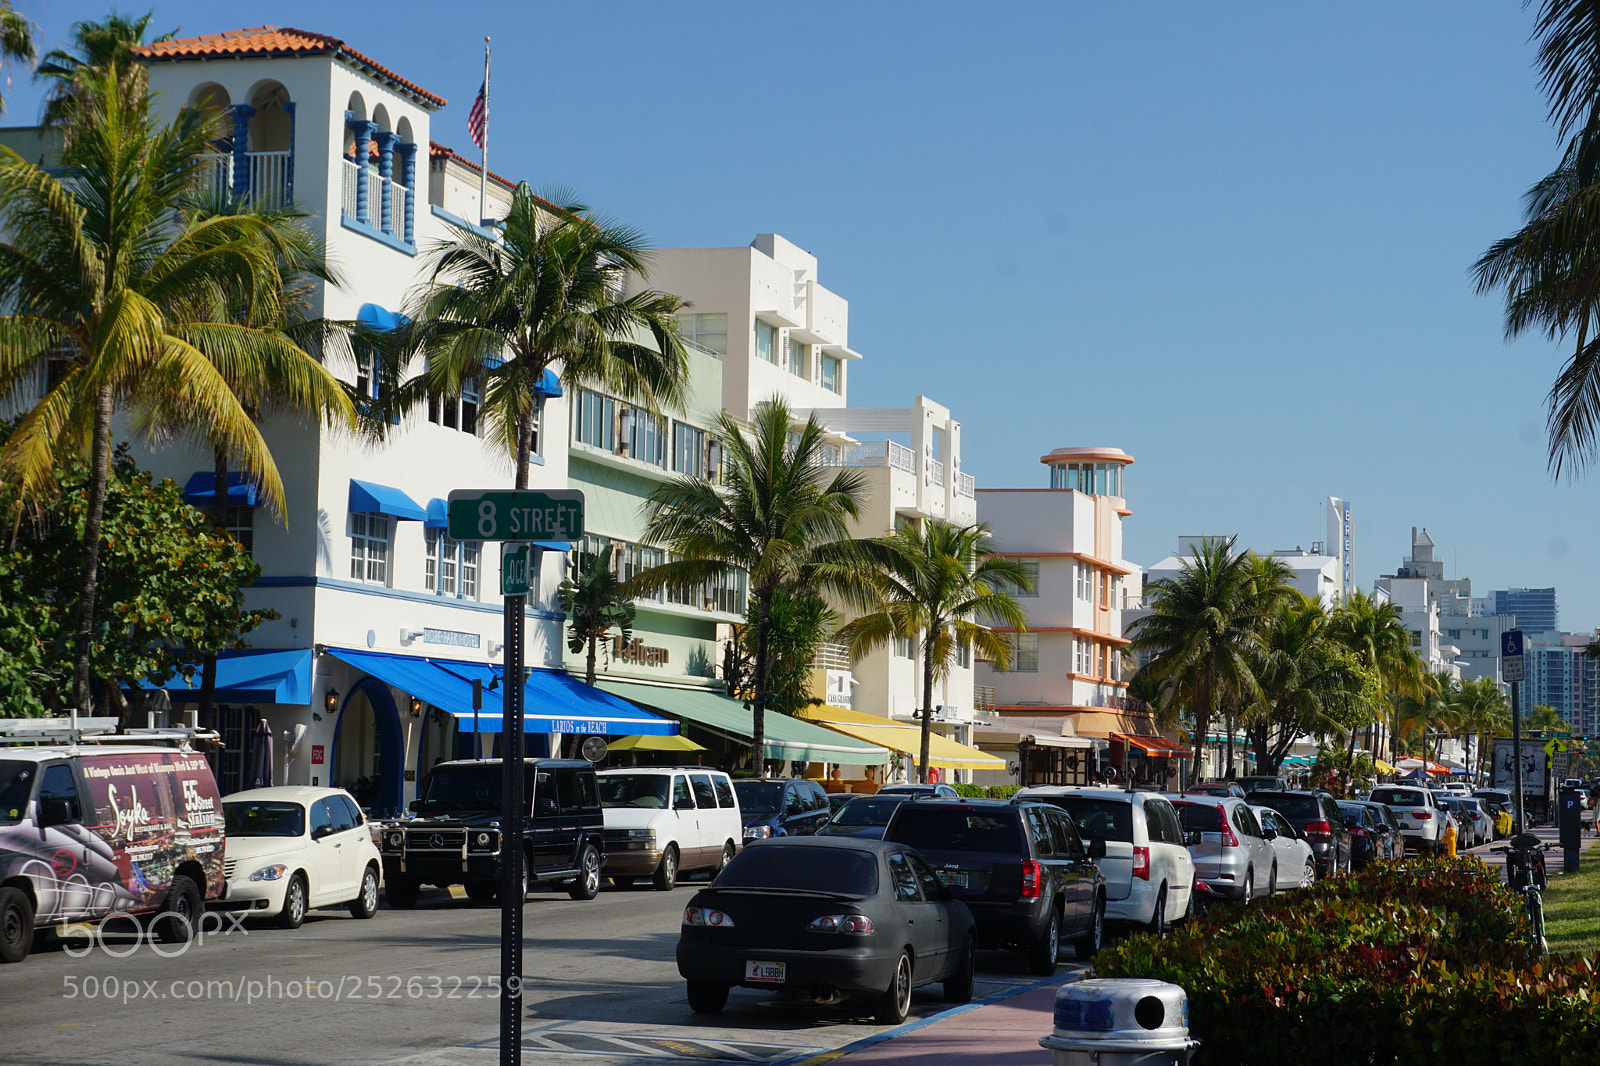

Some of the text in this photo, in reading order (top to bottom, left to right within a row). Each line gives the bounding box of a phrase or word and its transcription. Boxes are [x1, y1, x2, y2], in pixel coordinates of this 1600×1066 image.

[478, 500, 577, 538] 8 STREET
[459, 633, 479, 648] HOTEL
[551, 719, 574, 733] LARIOS
[587, 720, 607, 734] BEACH
[313, 749, 323, 760] FDC
[83, 767, 89, 778] A
[89, 766, 110, 779] Vintage
[110, 764, 124, 777] Oasis
[124, 764, 135, 775] Just
[135, 763, 148, 775] West
[148, 762, 153, 773] of
[182, 780, 214, 812] 55 Street
[108, 783, 150, 841] Soyka
[1567, 800, 1573, 809] P
[187, 811, 215, 829] Station
[135, 824, 159, 833] RESTAURANT
